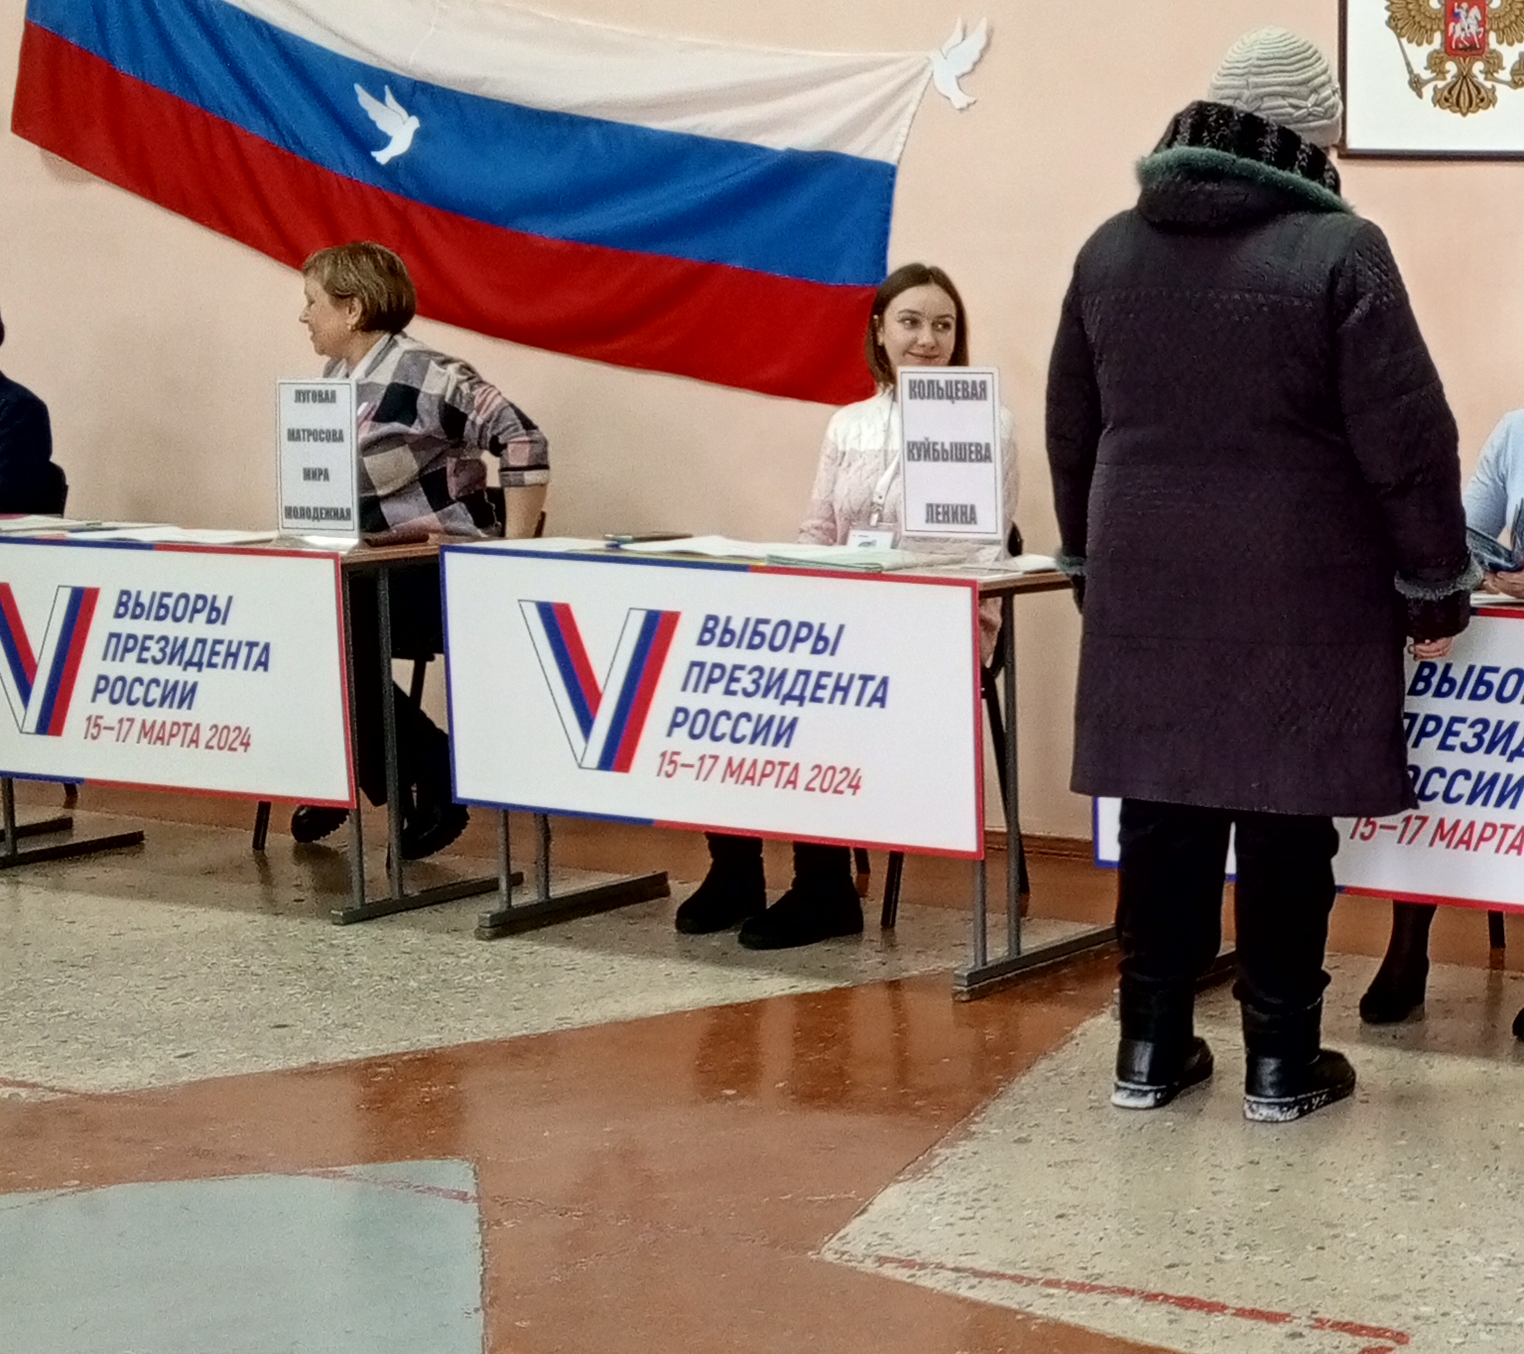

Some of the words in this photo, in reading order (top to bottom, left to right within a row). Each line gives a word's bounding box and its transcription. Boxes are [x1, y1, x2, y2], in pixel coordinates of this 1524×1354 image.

[294, 389, 337, 404] ЛУГОВАЯ
[908, 378, 988, 404] КОЛЬЦЕВАЯ
[287, 428, 344, 443] МАТРОСОВА
[906, 436, 993, 464] КУЙБЫШЕВА
[302, 466, 331, 482] МИРА
[925, 502, 978, 525] ЛЕНИНА
[112, 589, 233, 625] ВЫБОРЫ
[695, 613, 845, 657] ВЫБОРЫ
[101, 632, 272, 673] ПРЕЗИДЕНТА
[90, 674, 199, 711] РОССИИ
[680, 659, 890, 709] ПРЕЗИДЕНТА
[137, 720, 202, 750] МАРТА
[205, 724, 252, 753] 2024
[666, 706, 800, 749] РОССИИ
[720, 757, 802, 791] МАРТА
[804, 763, 863, 797] 2024
